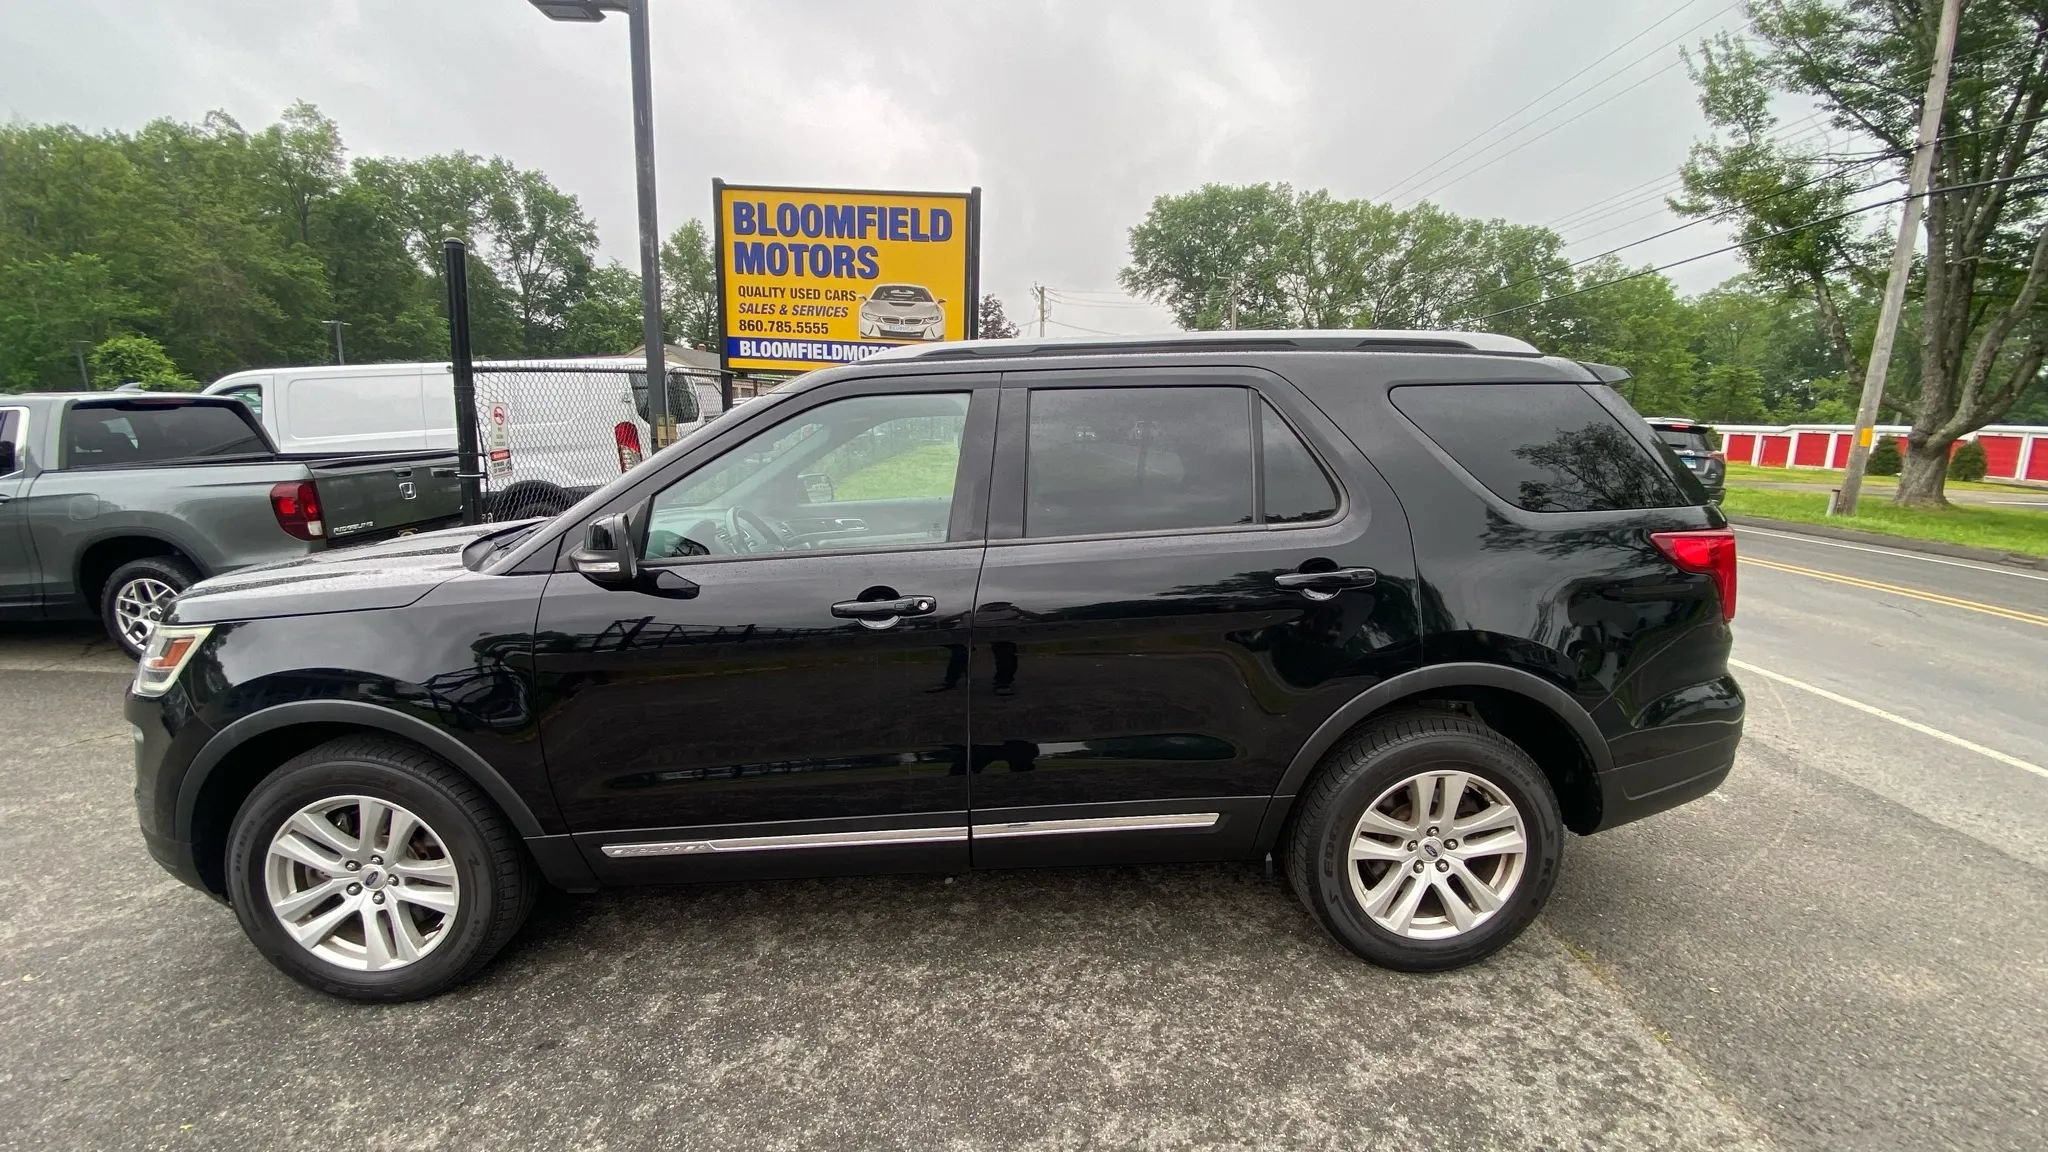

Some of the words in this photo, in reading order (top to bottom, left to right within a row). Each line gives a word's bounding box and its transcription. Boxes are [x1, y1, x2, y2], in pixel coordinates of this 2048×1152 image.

[734, 202, 952, 242] BLOOMFIELD
[735, 242, 879, 279] MOTORS
[738, 285, 786, 299] QUALITY
[790, 288, 821, 300] USED
[825, 289, 857, 302] CARS
[738, 302, 776, 315] SALES
[779, 304, 788, 315] &
[792, 305, 849, 318] SERVICES
[739, 319, 829, 335] 860.785.5555
[739, 341, 896, 361] BLOOMFIELDMOT
